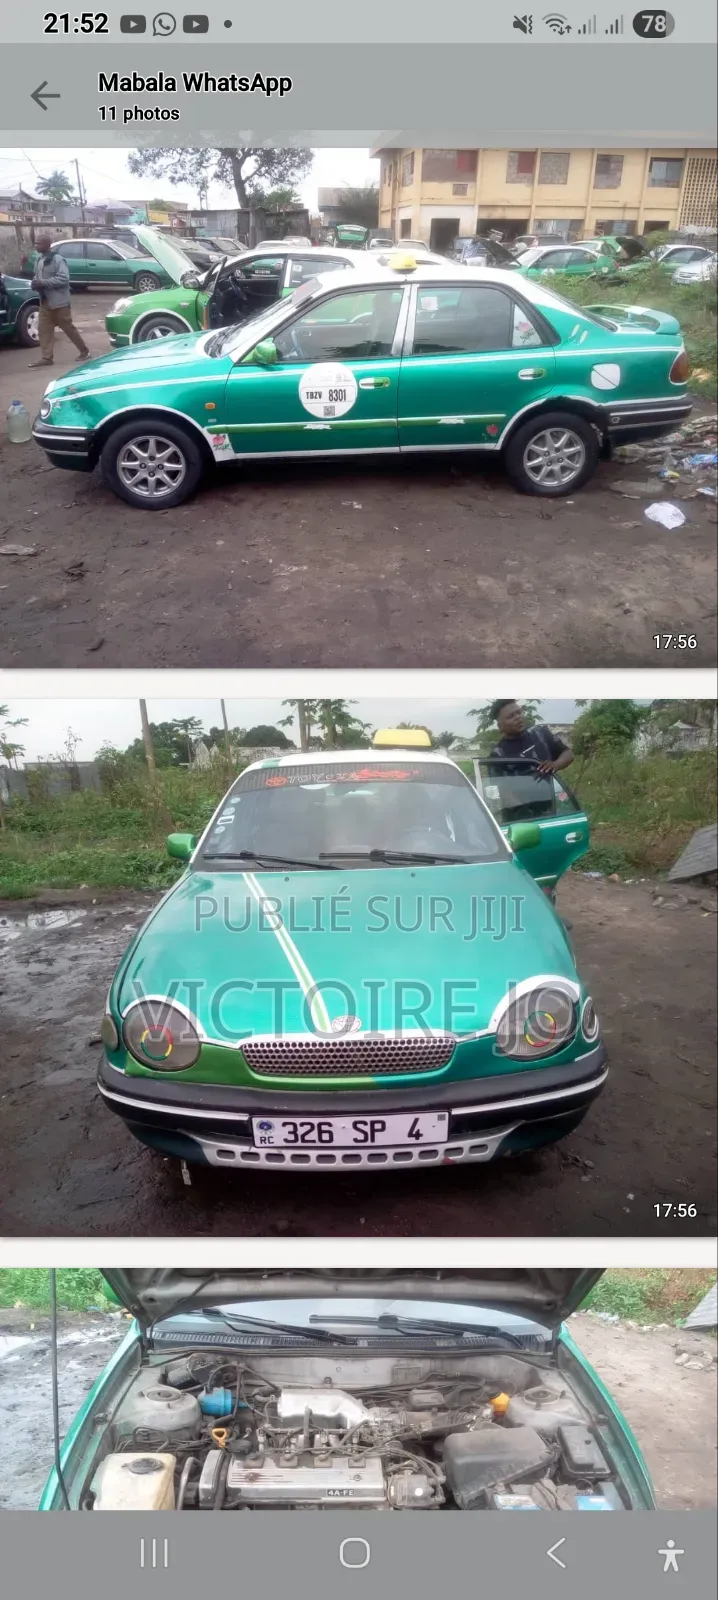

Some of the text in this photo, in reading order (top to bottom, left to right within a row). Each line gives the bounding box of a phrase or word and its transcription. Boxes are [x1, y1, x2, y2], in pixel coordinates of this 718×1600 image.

[43, 12, 109, 33] 21:52
[641, 14, 667, 33] 78
[99, 72, 292, 96] Mabala WhatsApp
[99, 105, 180, 123] 11 photos
[305, 388, 347, 402] TBZV 8301
[653, 634, 698, 649] 17:56
[282, 1117, 424, 1144] 326 SP 4
[259, 1136, 275, 1145] RC
[653, 1203, 698, 1218] 17:56
[328, 1489, 354, 1497] 4A-FE
